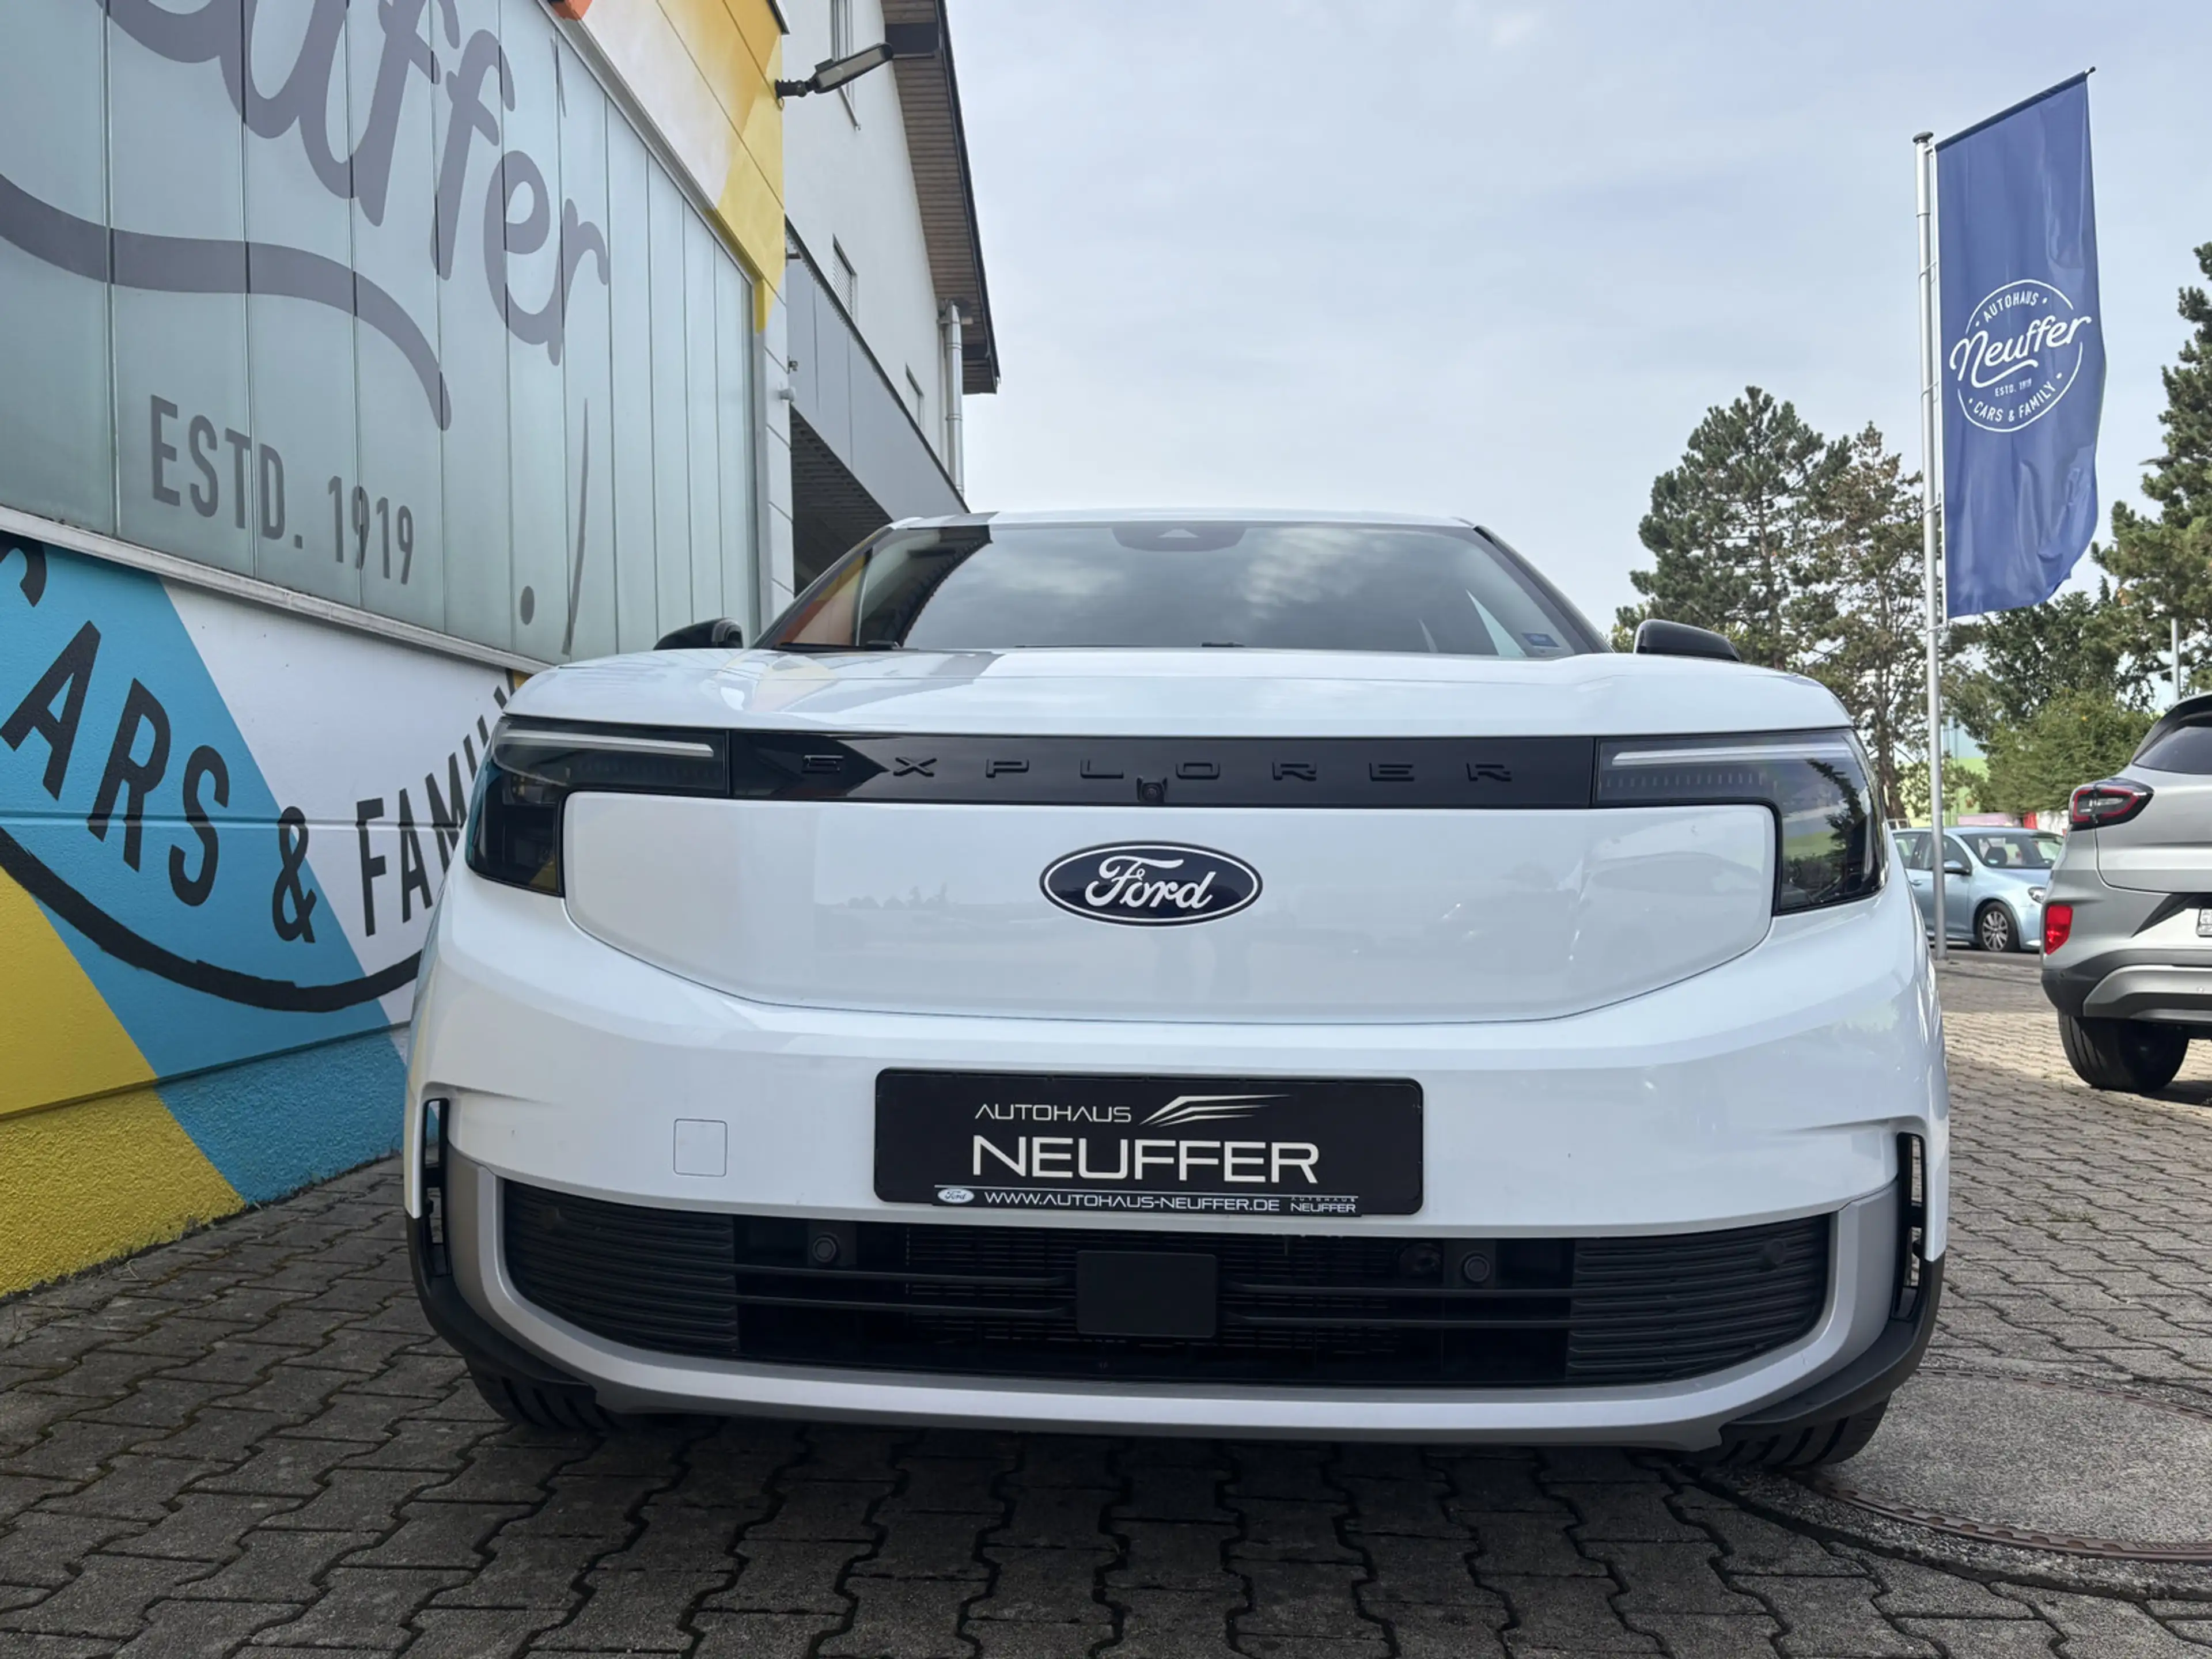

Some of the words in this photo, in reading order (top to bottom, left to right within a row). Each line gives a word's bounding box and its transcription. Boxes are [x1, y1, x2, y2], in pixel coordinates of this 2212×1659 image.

[1983, 290, 2039, 323] AUTOHAUS
[1949, 315, 2092, 388] Neuffer
[1974, 400, 2004, 423] CARS
[2008, 409, 2015, 422] &
[2018, 380, 2056, 419] FAMILY
[150, 394, 303, 541] ESTD.
[328, 475, 414, 585] 1919
[801, 753, 1513, 782] EXPLORER
[271, 806, 317, 944] &
[1084, 855, 1217, 911] Ford
[974, 1103, 1132, 1123] AUTOHAUS
[972, 1134, 1319, 1184] NEUFFER
[984, 1191, 1280, 1211] WWW.AUTOHAUS-NEUFFER.DE
[1290, 1202, 1356, 1213] NEUFFER
